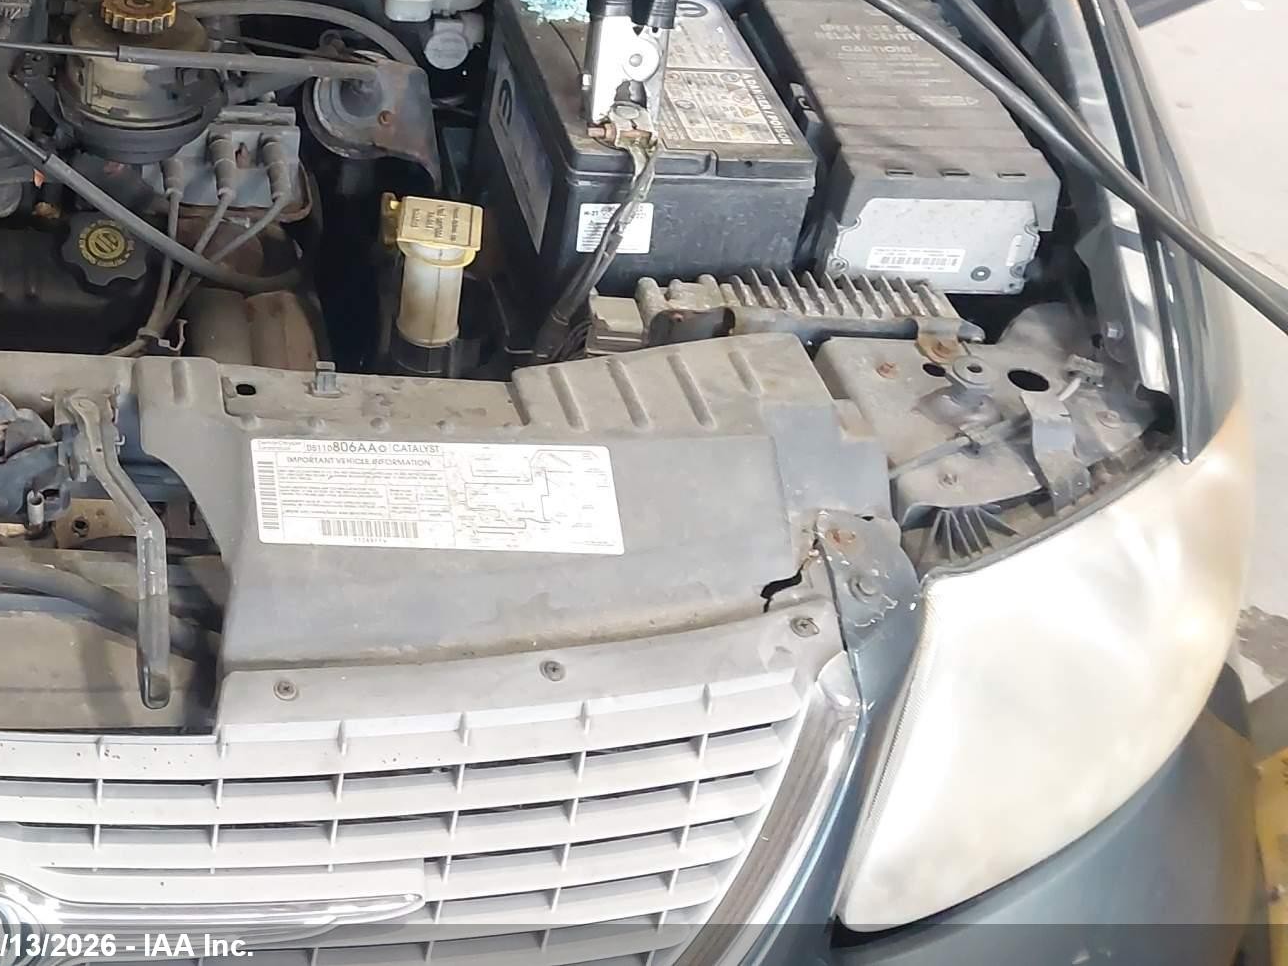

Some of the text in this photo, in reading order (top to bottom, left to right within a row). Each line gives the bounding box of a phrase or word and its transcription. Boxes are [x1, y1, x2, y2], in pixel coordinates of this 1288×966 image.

[392, 443, 440, 453] CATALYST
[287, 456, 431, 467] IMPORTANT VEHICLE INFORMATION
